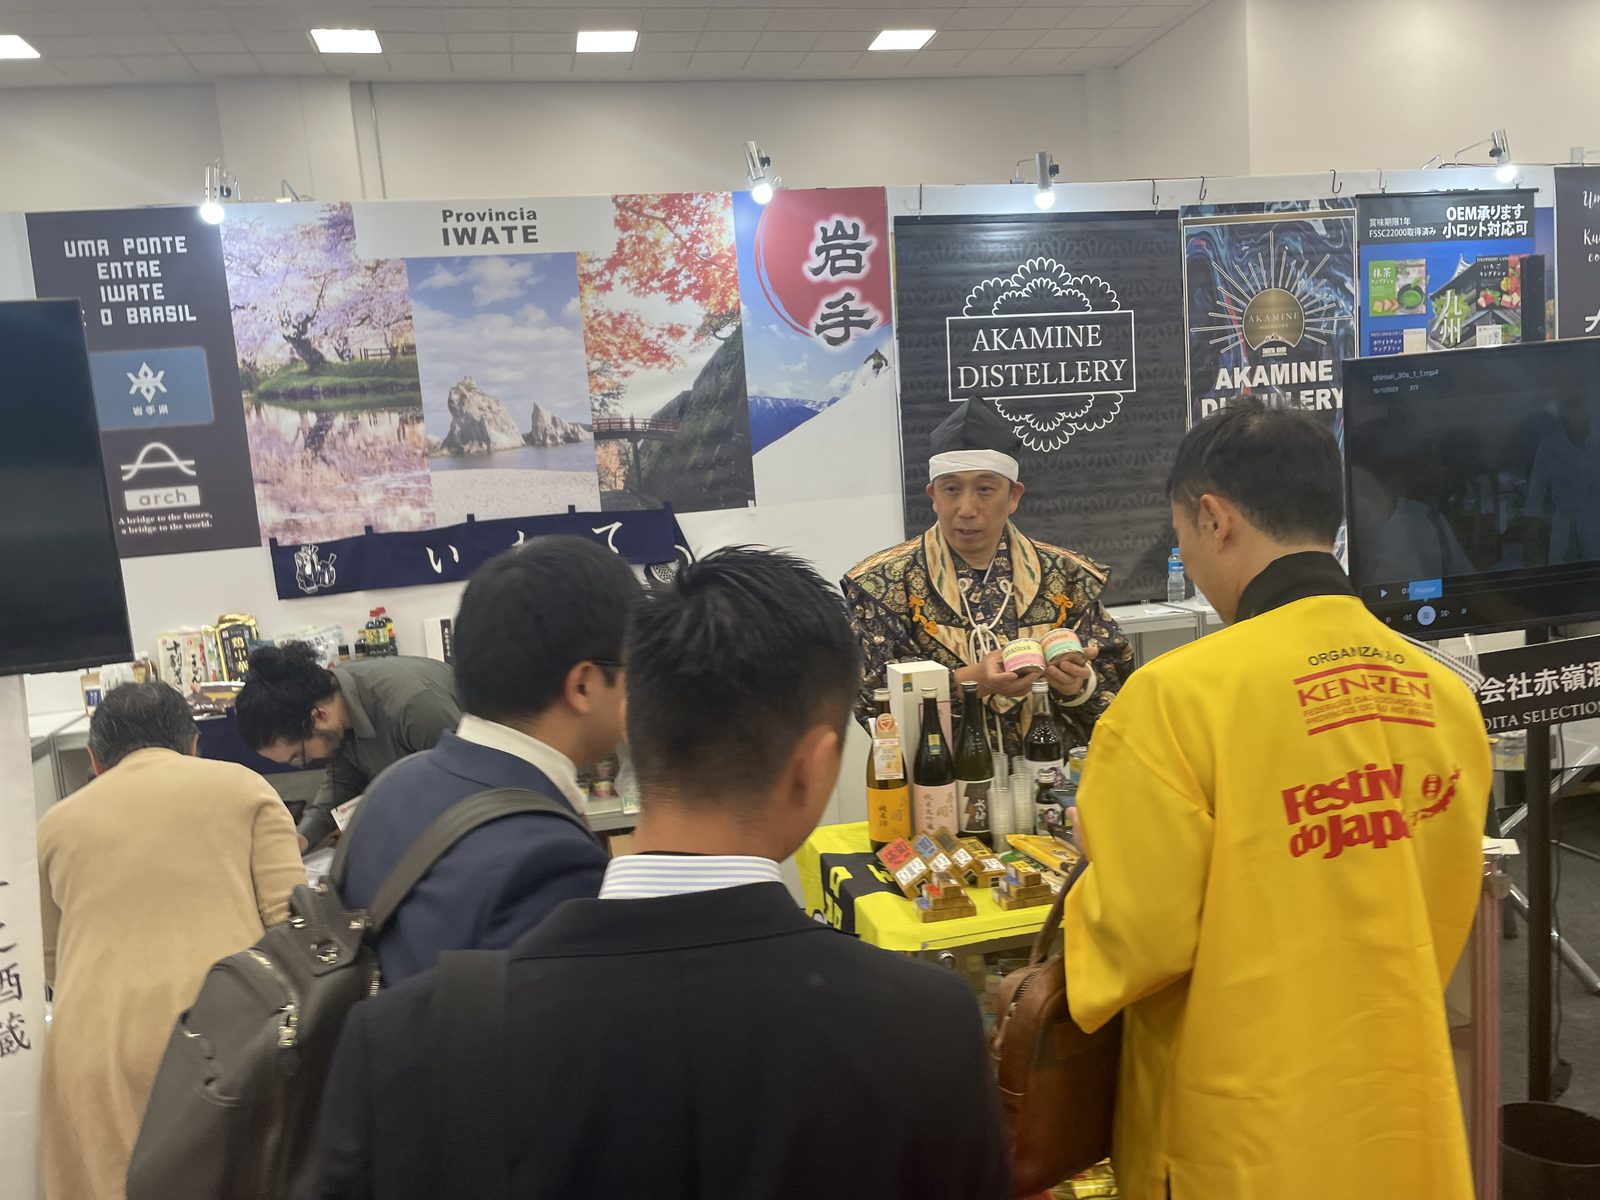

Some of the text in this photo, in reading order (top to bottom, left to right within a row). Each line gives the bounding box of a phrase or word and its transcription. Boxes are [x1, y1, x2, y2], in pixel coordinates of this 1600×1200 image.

[442, 207, 537, 223] Provincia
[1446, 204, 1525, 221] OEM承ります
[442, 225, 539, 246] IWATE
[1369, 227, 1437, 238] FSSC22000取得済み
[1442, 220, 1529, 239] 小ロット対応可
[64, 235, 188, 258] UMA PONTE
[96, 260, 162, 280] ENTRE
[100, 283, 165, 303] IWATE
[807, 220, 879, 346] 岩手
[100, 308, 113, 326] O
[126, 304, 197, 325] BRASIL
[1249, 312, 1300, 324] AKAMINE
[1430, 289, 1462, 344] 九州
[972, 324, 1103, 352] AKAMINE
[957, 358, 1128, 389] DISTELLERY
[1215, 359, 1333, 390] AKAMINE
[138, 489, 187, 506] arch
[119, 517, 125, 525] A
[126, 515, 155, 524] bridge
[168, 513, 181, 521] the
[183, 511, 212, 520] future,
[128, 525, 157, 534] bridge
[170, 523, 183, 531] the
[185, 520, 212, 529] world.
[1297, 674, 1431, 707] KENREN
[1523, 701, 1600, 724] SELECTIO
[1289, 824, 1326, 858] do
